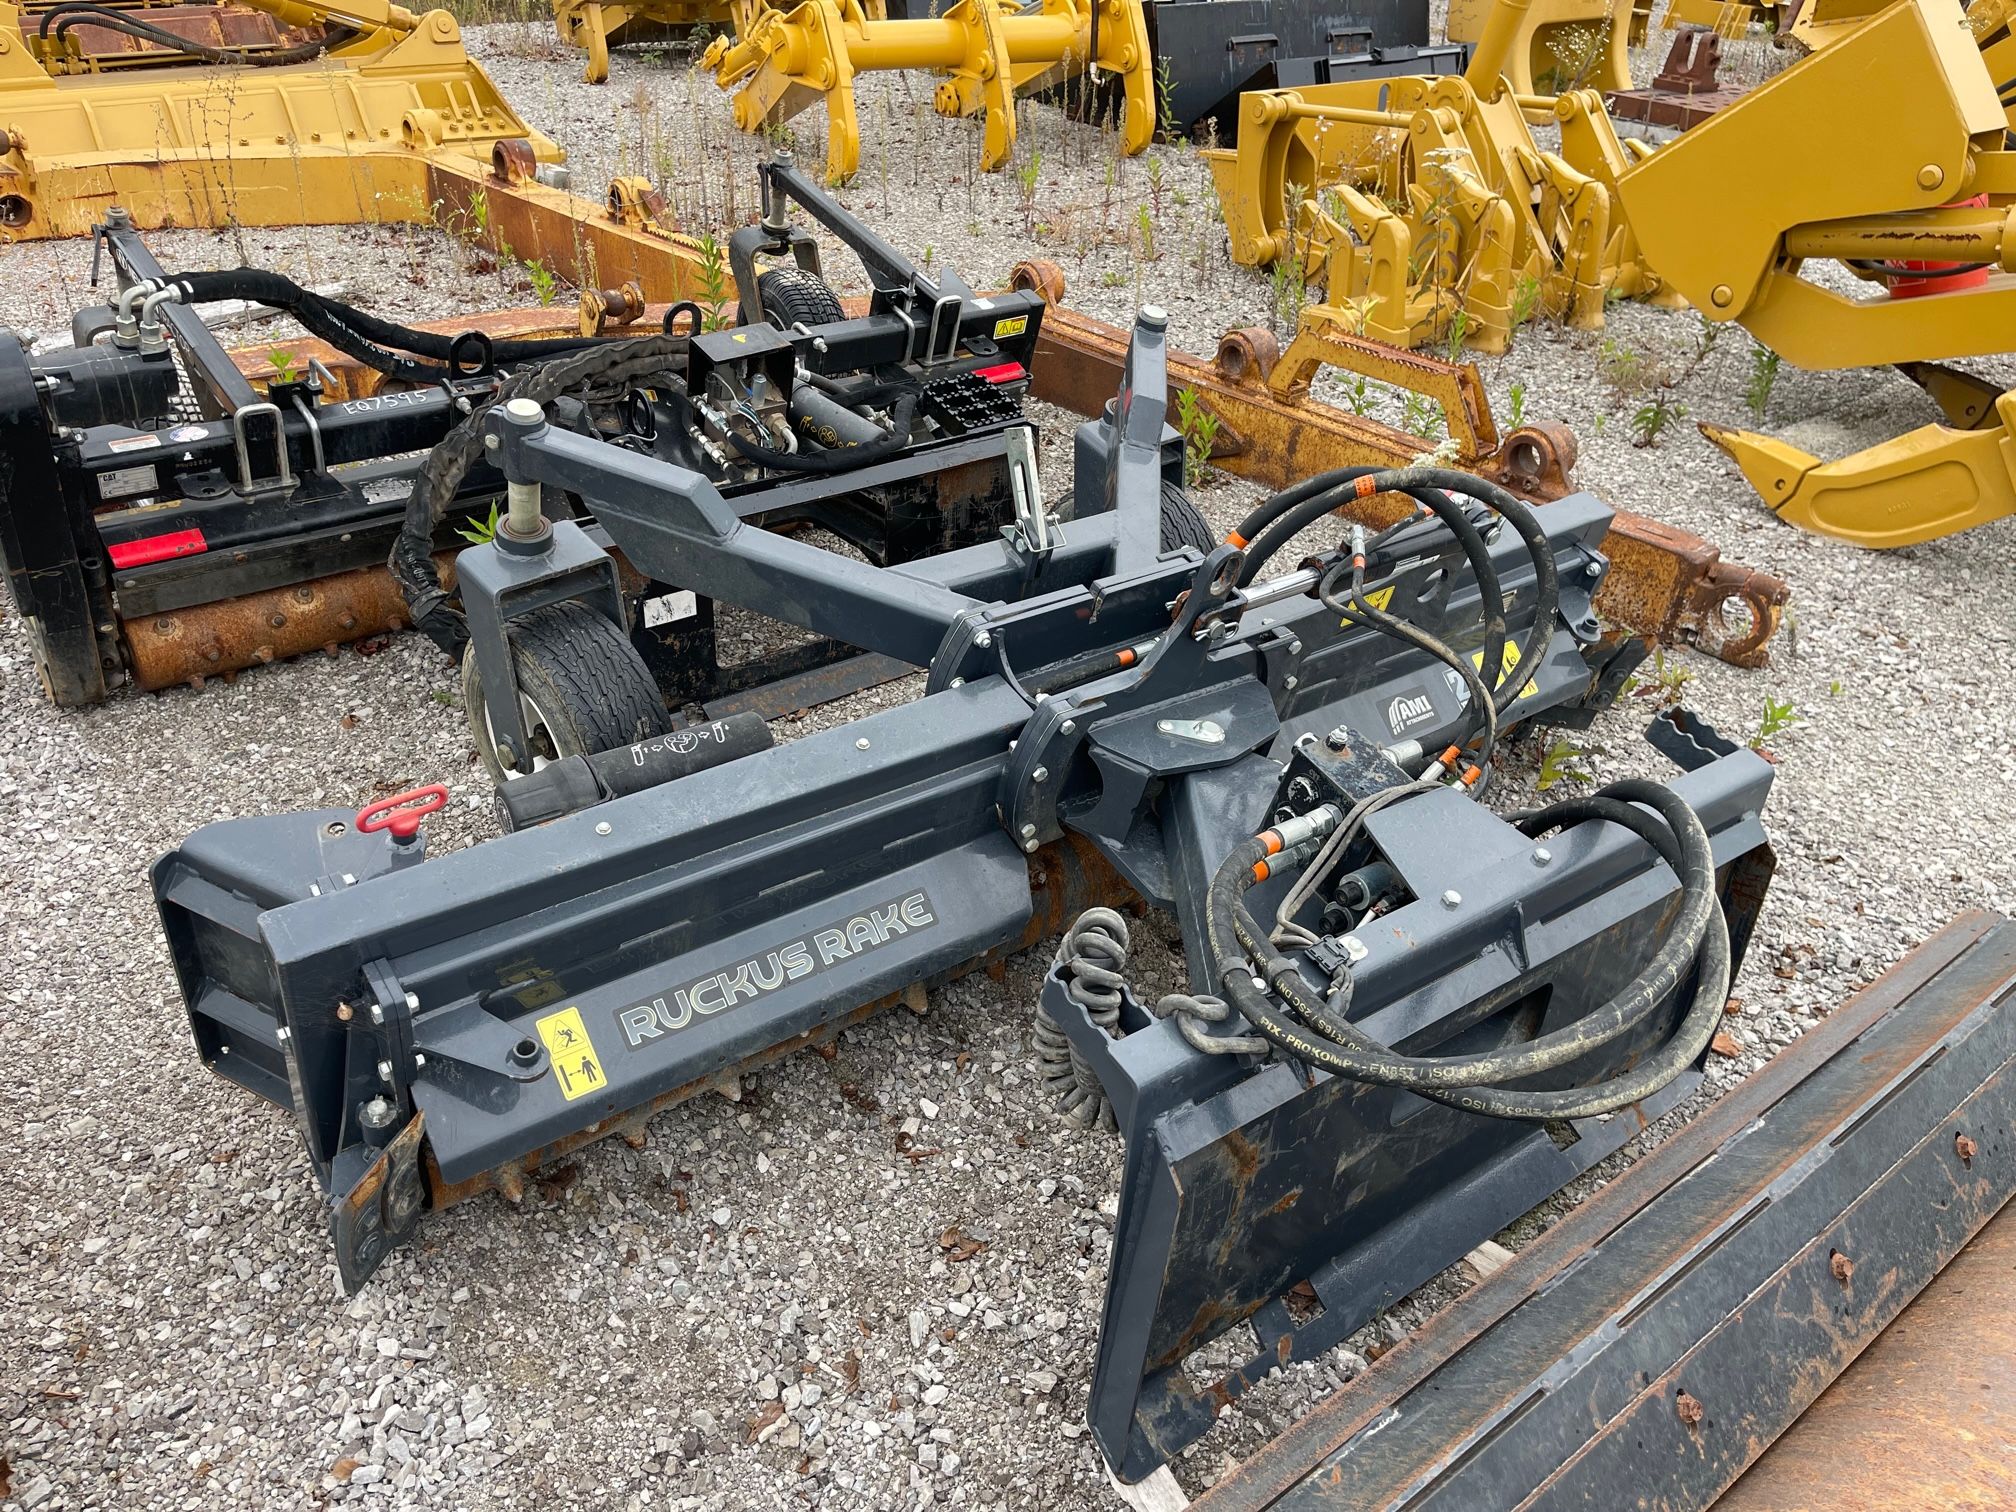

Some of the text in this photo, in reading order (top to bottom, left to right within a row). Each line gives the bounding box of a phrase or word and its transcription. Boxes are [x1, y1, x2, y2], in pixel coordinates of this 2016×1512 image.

[342, 389, 428, 415] EQ7595
[103, 473, 117, 482] CAT
[1399, 694, 1433, 720] AMI
[1406, 711, 1435, 726] ATTACHMENTS
[620, 893, 934, 1046] RUCKUS RAKE
[1276, 979, 1293, 998] DN1
[1292, 997, 1313, 1017] 2SC
[1462, 1097, 1486, 1110] ISO
